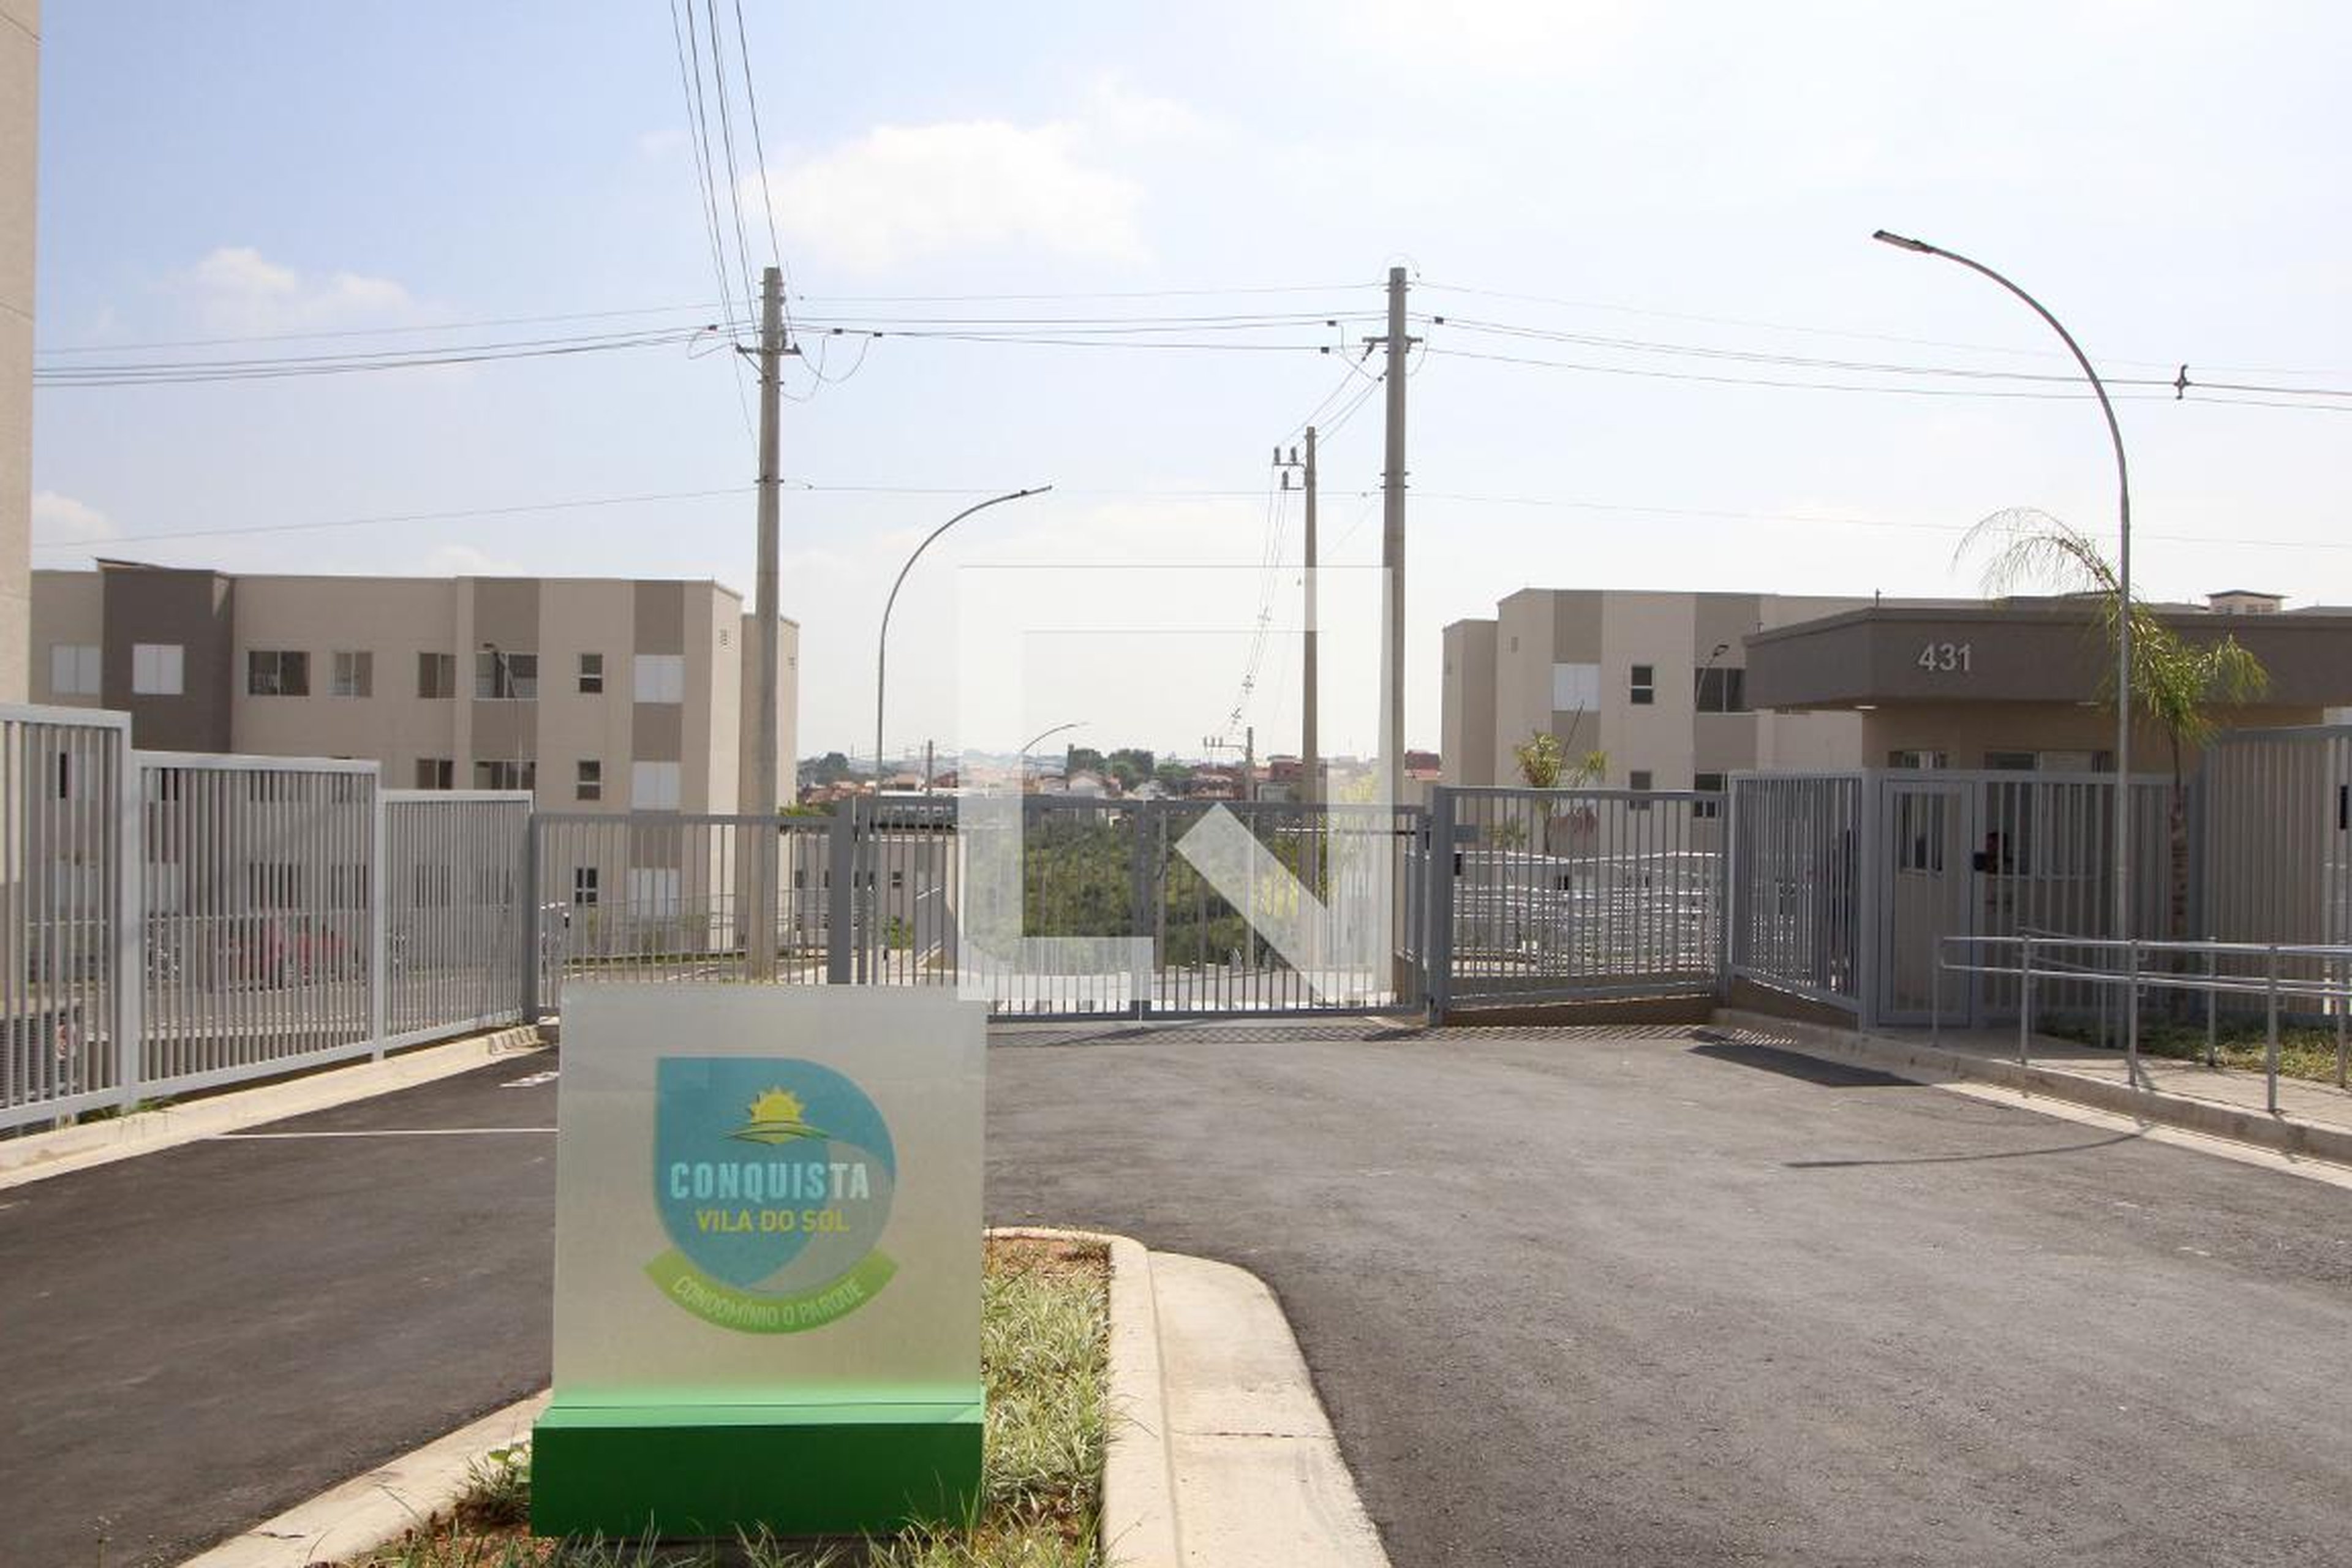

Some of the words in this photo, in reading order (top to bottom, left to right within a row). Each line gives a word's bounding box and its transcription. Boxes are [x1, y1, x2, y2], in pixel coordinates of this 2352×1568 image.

[1918, 643, 1970, 671] 431
[671, 1163, 869, 1202] CONQUISTA
[696, 1209, 753, 1232] VILA
[760, 1209, 795, 1232] DO
[802, 1209, 850, 1232] SOL
[783, 1305, 795, 1326] O
[799, 1277, 864, 1324] PARQUE
